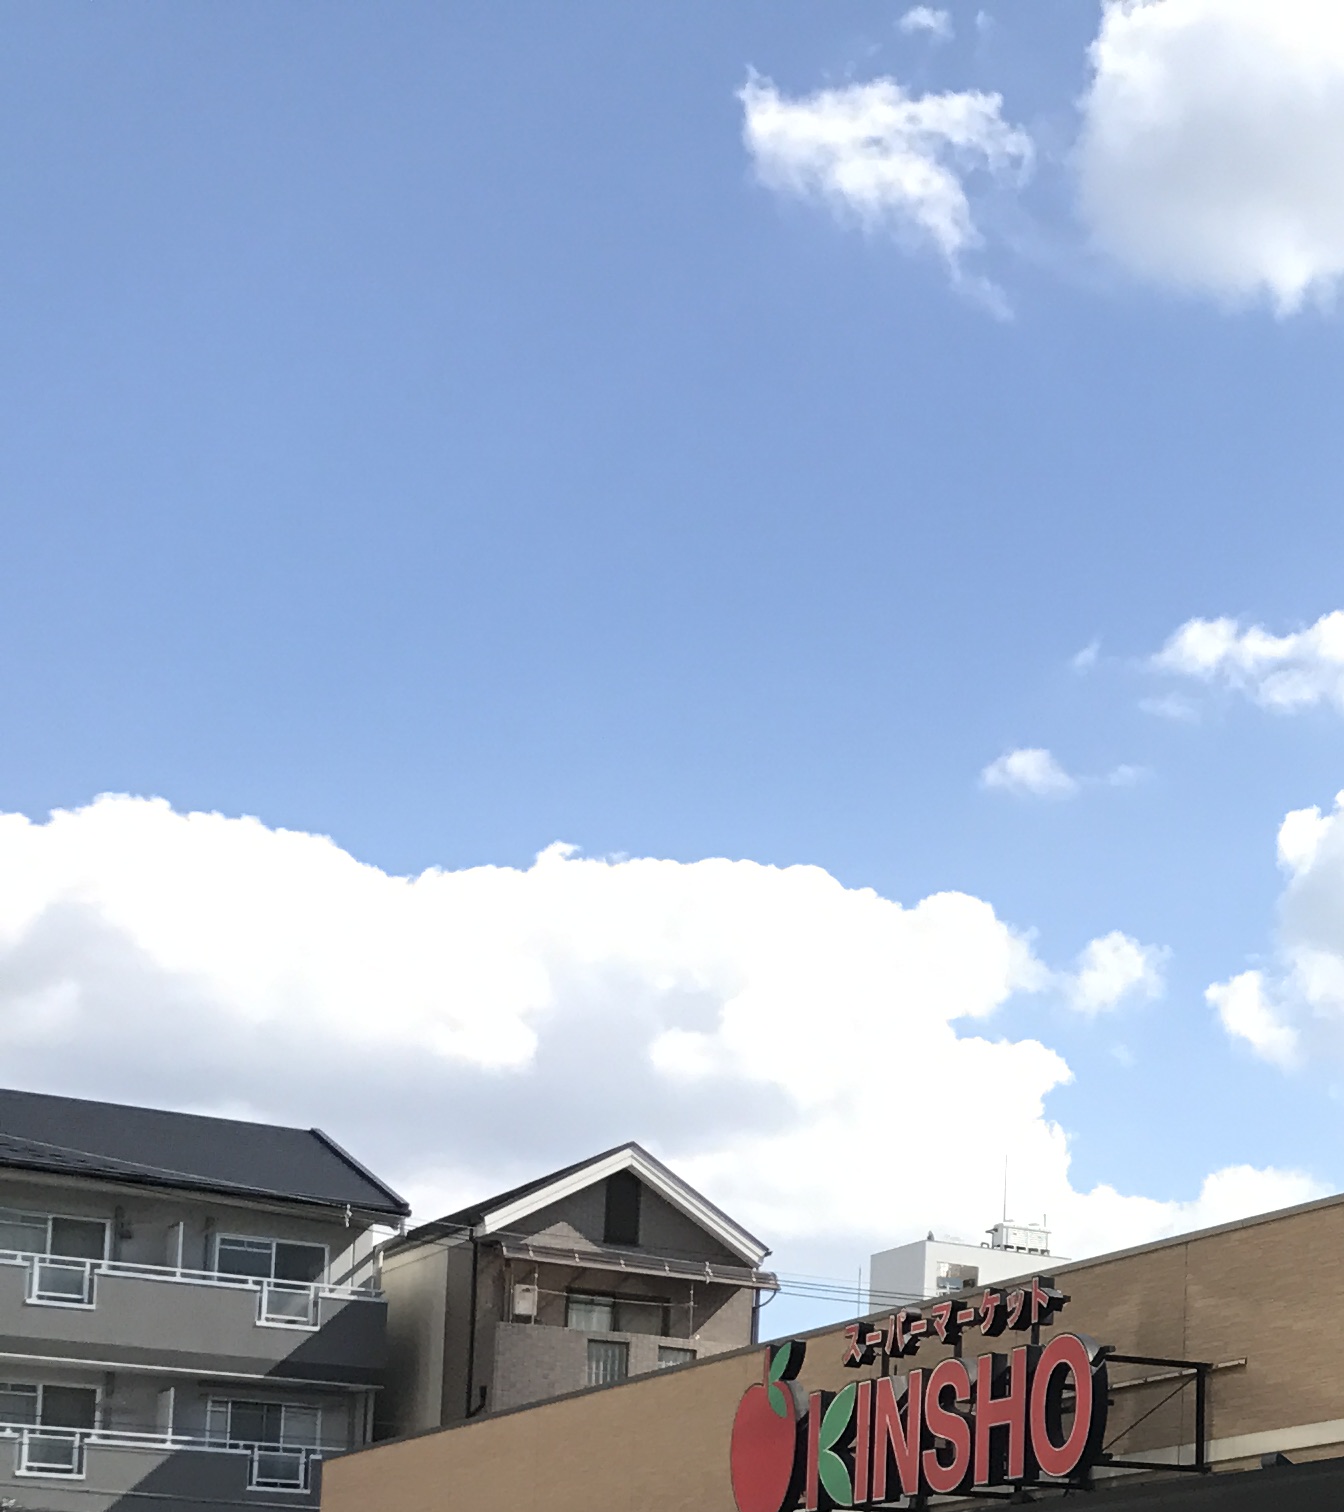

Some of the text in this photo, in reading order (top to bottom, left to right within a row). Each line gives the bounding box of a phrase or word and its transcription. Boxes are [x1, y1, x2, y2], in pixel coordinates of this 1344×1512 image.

[843, 1275, 1052, 1368] スーパーマーケット
[805, 1332, 1094, 1512] KINSHO
